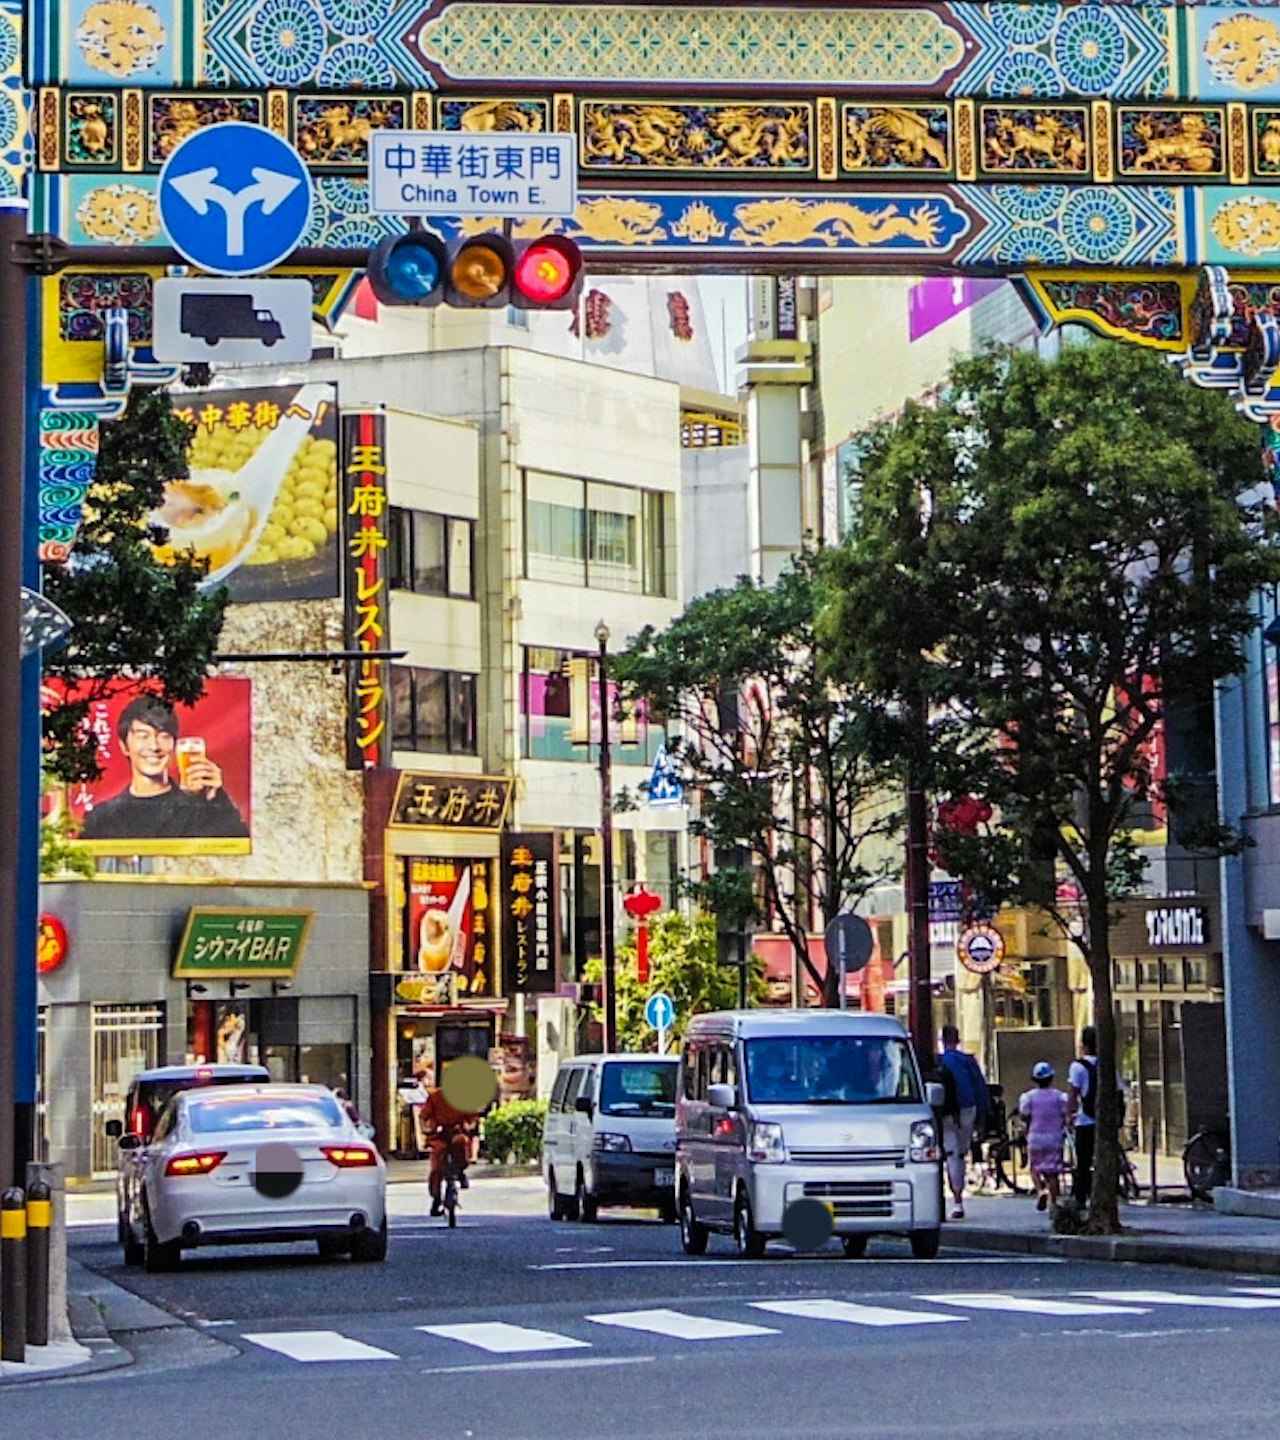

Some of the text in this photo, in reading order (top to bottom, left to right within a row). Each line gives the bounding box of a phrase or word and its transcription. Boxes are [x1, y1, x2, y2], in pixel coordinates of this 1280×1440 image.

[384, 144, 562, 181] 中華街東門
[401, 184, 546, 205] China Town E.
[346, 444, 388, 749] 王府井レストラン
[406, 783, 501, 822] 王府井
[193, 935, 292, 961] シウマイBAR
